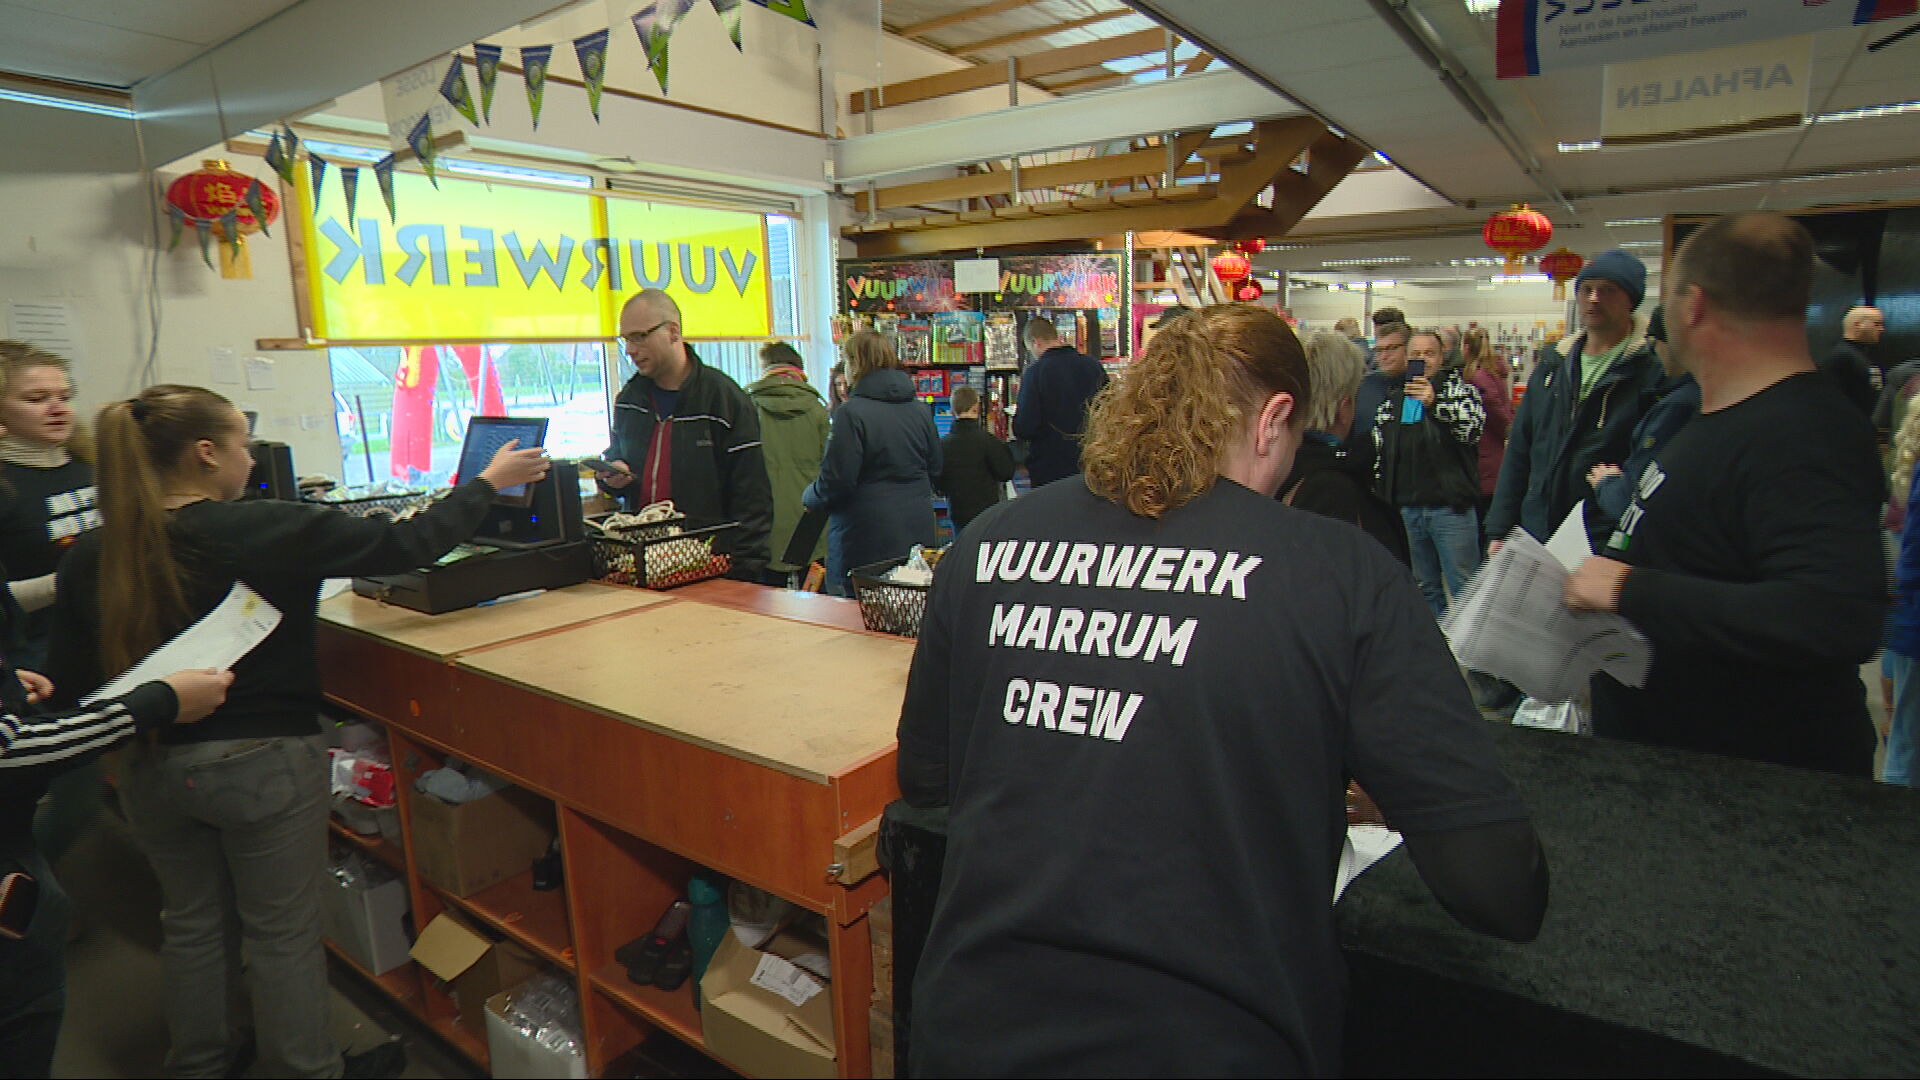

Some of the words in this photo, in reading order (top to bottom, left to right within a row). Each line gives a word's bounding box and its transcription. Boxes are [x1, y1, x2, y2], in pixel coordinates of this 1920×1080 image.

[1559, 30, 1620, 48] Aansteken
[1641, 17, 1687, 35] afstand
[1691, 8, 1748, 26] bewaren
[1617, 11, 1647, 26] hand
[1650, 3, 1698, 20] houden
[847, 275, 954, 301] VUURWER
[975, 539, 1263, 600] VUURWERK
[988, 603, 1198, 667] MARRUM
[1003, 678, 1144, 742] CREW
